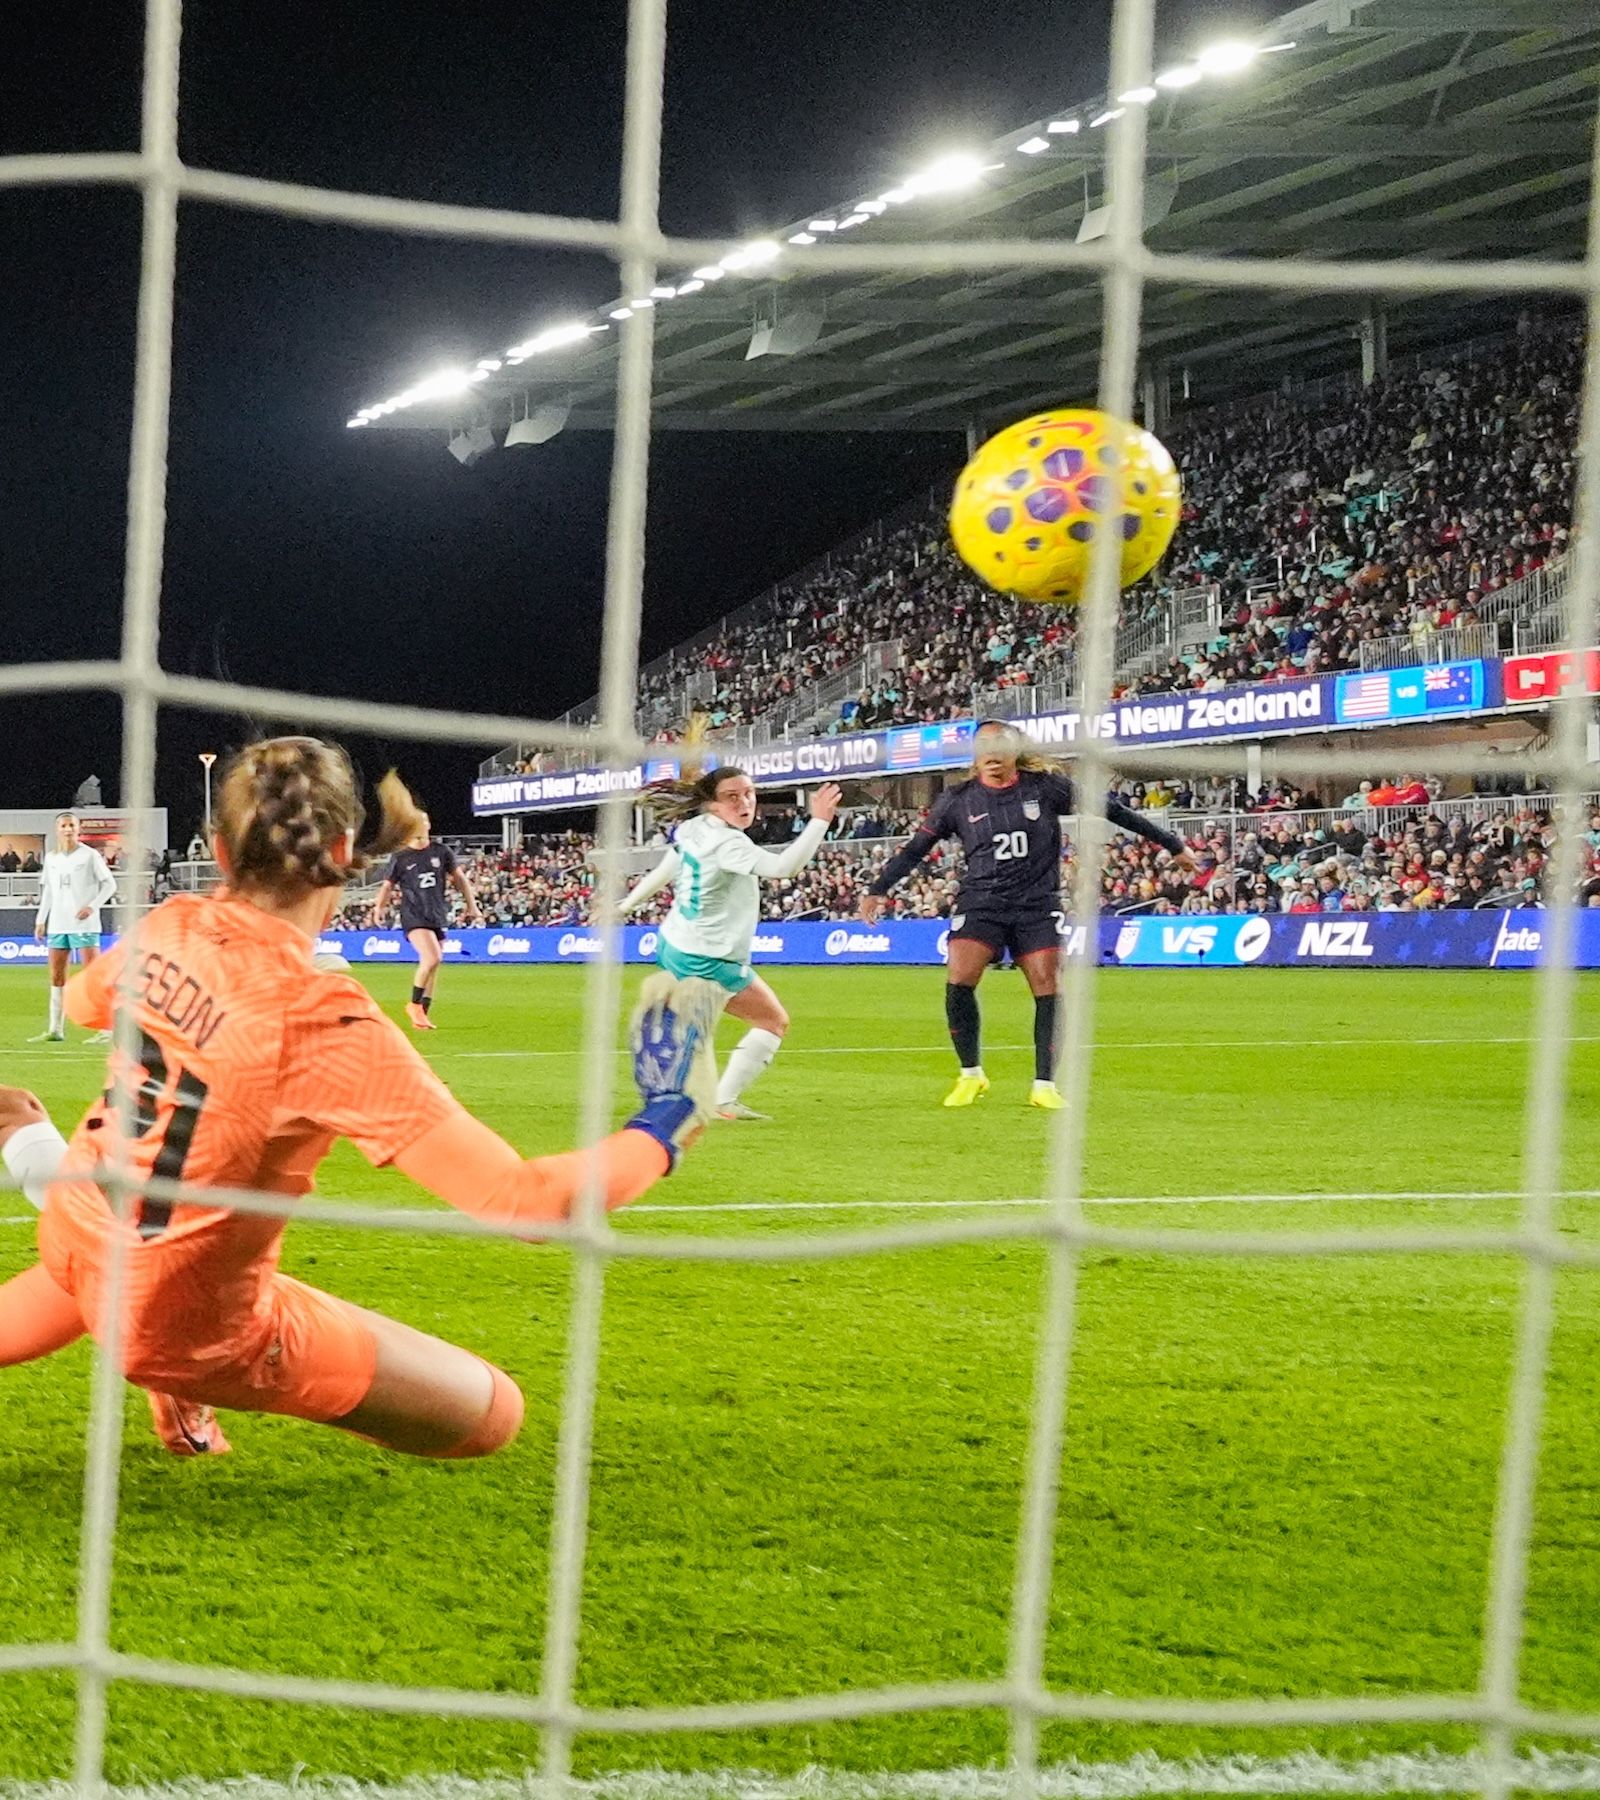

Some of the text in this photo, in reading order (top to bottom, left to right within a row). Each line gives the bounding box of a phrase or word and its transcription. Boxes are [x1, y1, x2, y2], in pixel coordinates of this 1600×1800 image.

[1085, 713, 1117, 739] vs
[1120, 703, 1184, 737] New
[1188, 684, 1322, 730] Zealand
[795, 742, 841, 773] City,
[844, 738, 877, 765] MO
[473, 766, 643, 806] USWNT vs New Zealand
[992, 830, 1028, 861] 20
[418, 872, 437, 889] 25
[1162, 926, 1218, 954] VS
[1297, 921, 1375, 957] NZL
[114, 948, 228, 1051] SSON
